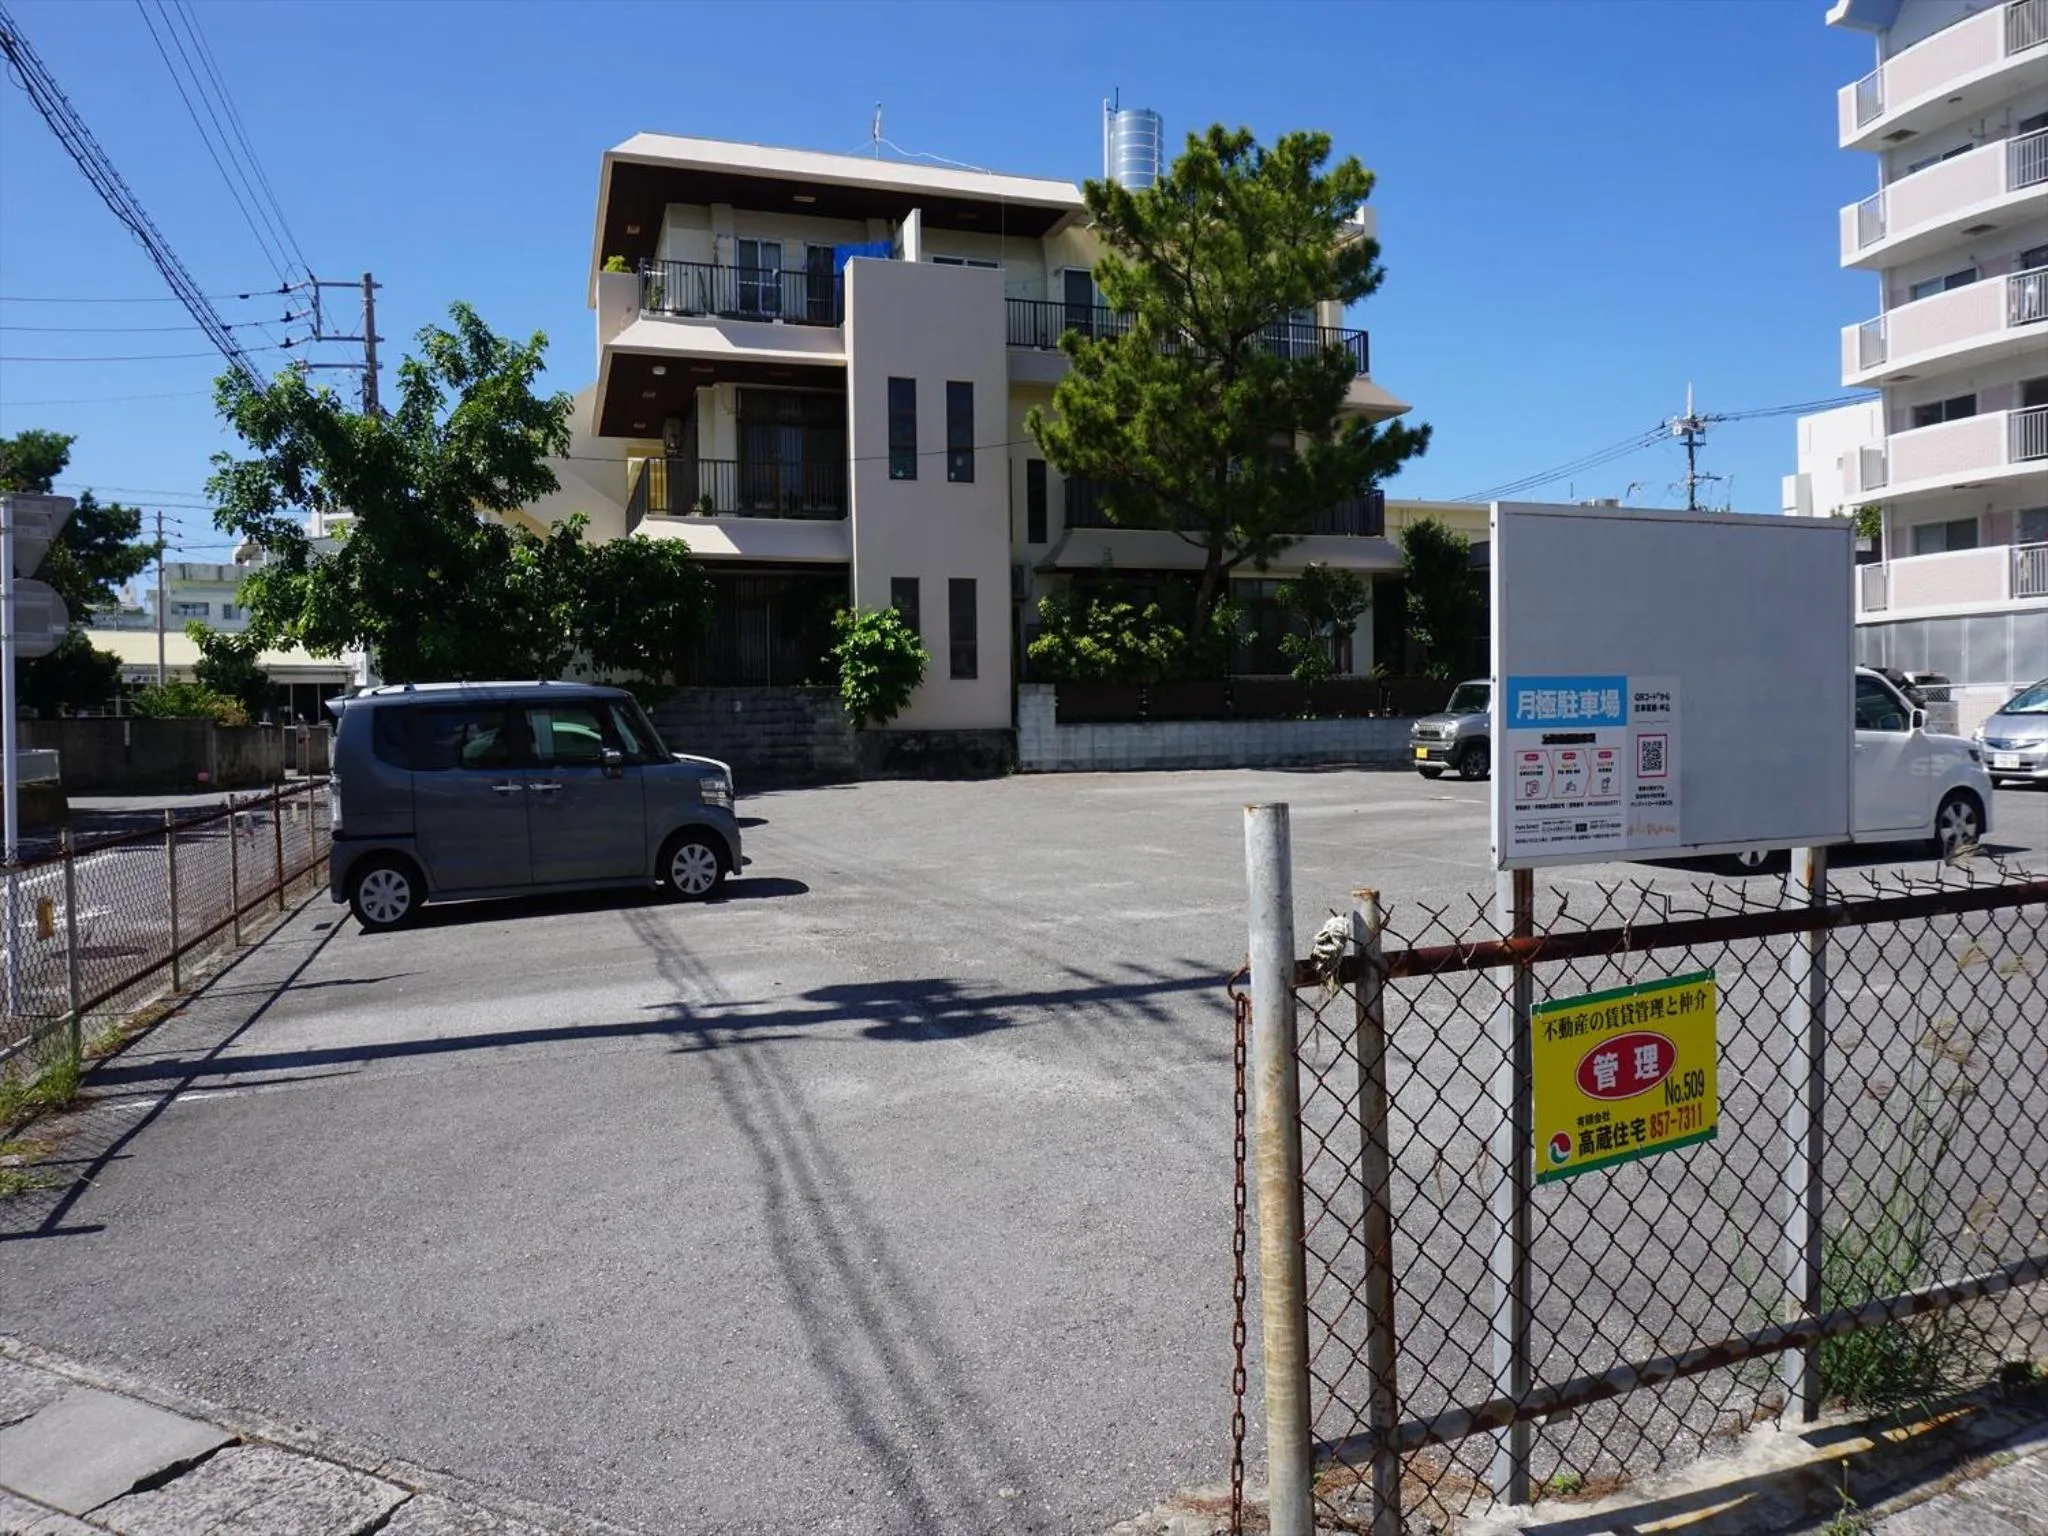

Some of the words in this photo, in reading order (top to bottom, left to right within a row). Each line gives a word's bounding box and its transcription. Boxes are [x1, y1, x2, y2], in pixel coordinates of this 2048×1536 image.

[1516, 688, 1620, 720] 月極駐車場
[1543, 989, 1708, 1042] 不動産の賃貸管理と仲介
[1593, 1043, 1660, 1092] 管理
[1664, 1069, 1705, 1107] No.509
[1576, 1110, 1611, 1126] 有限会社
[1578, 1117, 1646, 1157] 高蔵住宅
[1650, 1102, 1703, 1140] 857-7311
